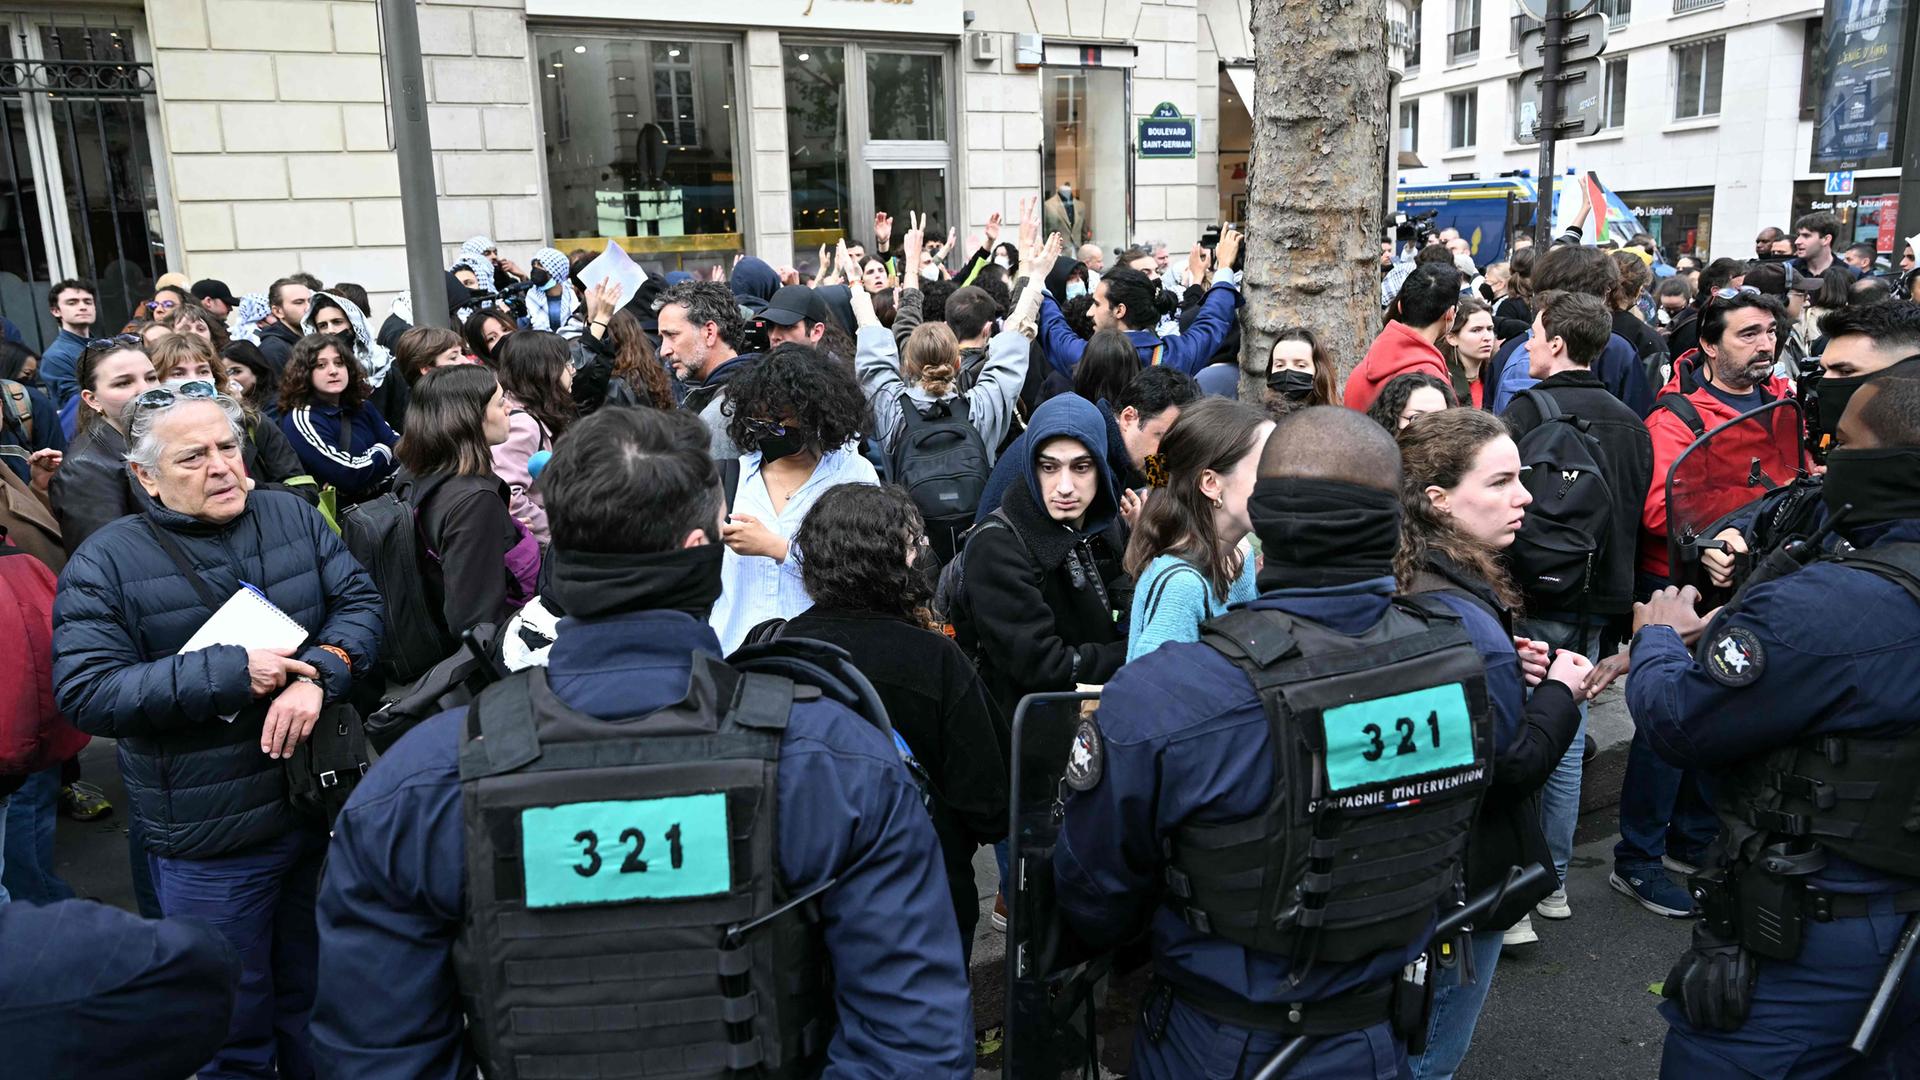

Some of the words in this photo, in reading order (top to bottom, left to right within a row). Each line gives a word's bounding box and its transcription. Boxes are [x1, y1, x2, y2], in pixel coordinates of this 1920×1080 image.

[1142, 140, 1192, 149] SAINT-GERMAIN
[1147, 127, 1187, 136] BOULEVARD
[1811, 199, 1857, 210] ScienesPo
[1858, 198, 1894, 208] Librairie
[1361, 709, 1441, 762] 321
[1307, 790, 1386, 814] CPAGNIE
[1391, 767, 1485, 801] D'INTERVENTION
[572, 822, 684, 879] 321
